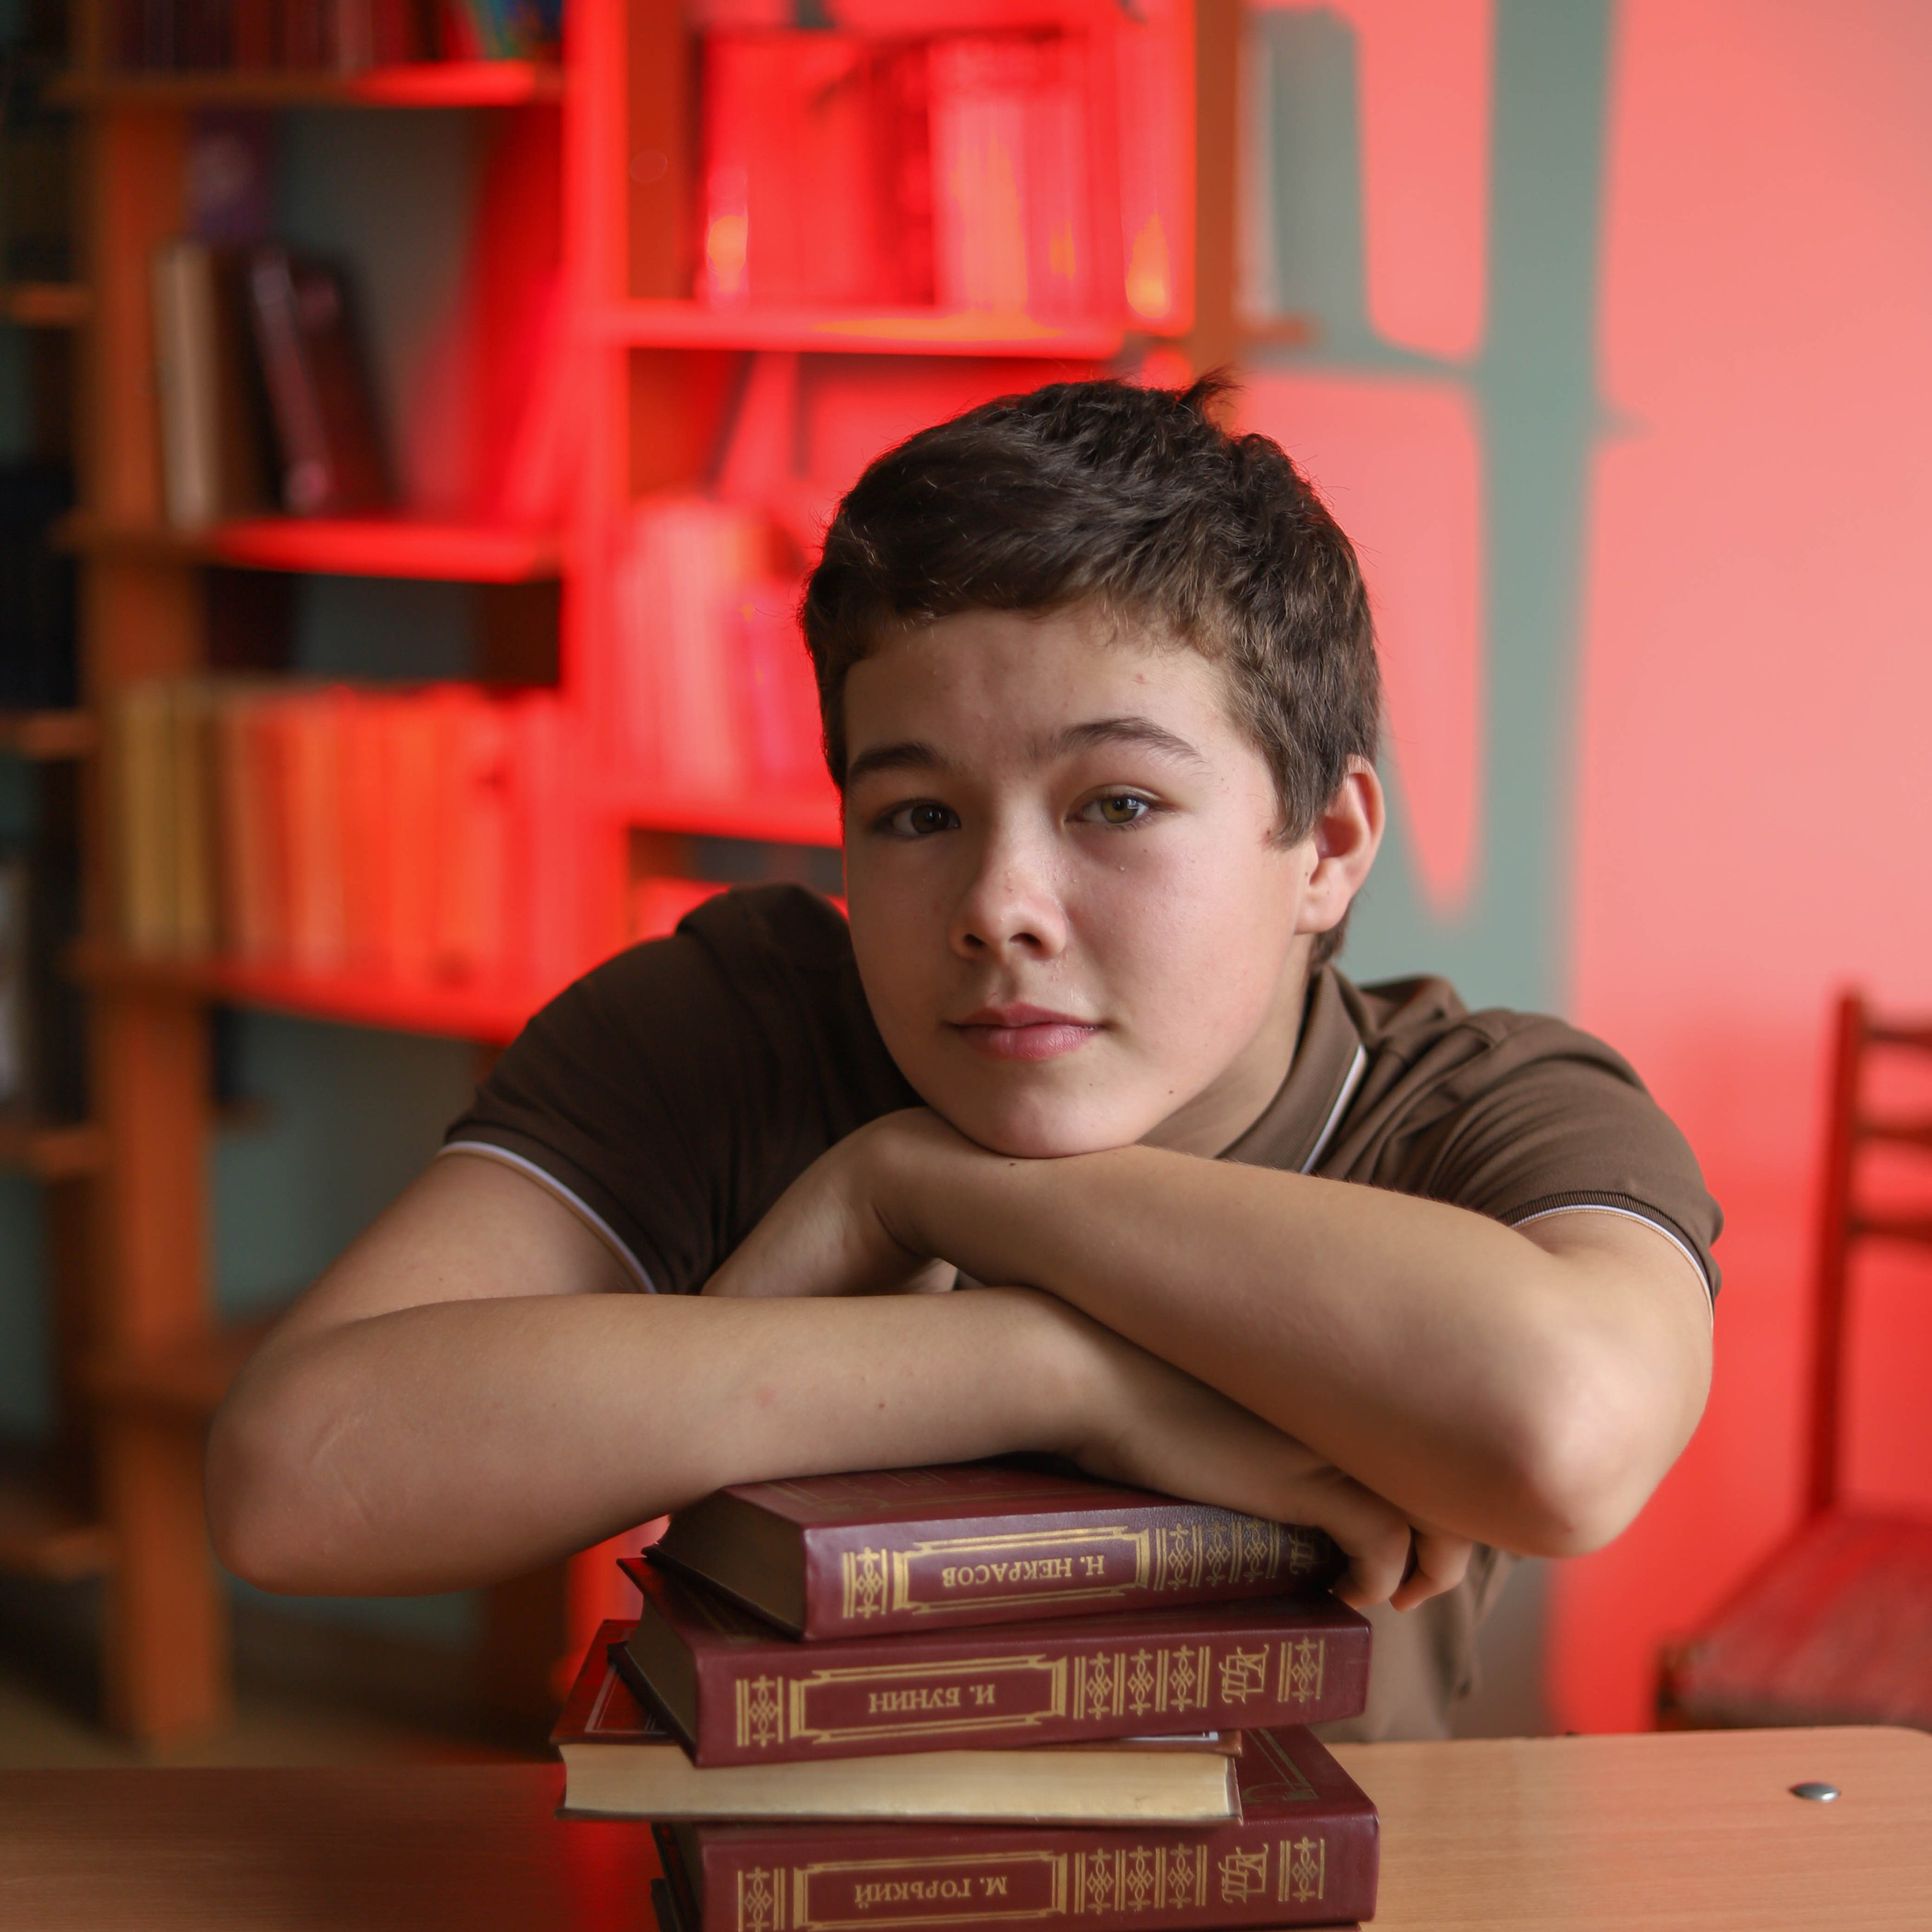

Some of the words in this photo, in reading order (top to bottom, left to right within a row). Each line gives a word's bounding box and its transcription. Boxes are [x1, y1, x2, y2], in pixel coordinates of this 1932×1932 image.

[942, 1557, 1072, 1587] НЕКРАСОВ
[1080, 1555, 1105, 1575] Н.
[869, 1687, 961, 1714] БУНИН
[969, 1684, 995, 1705] И.
[854, 1878, 971, 1909] ГОРЬКИЙ
[980, 1876, 1008, 1896] М.
